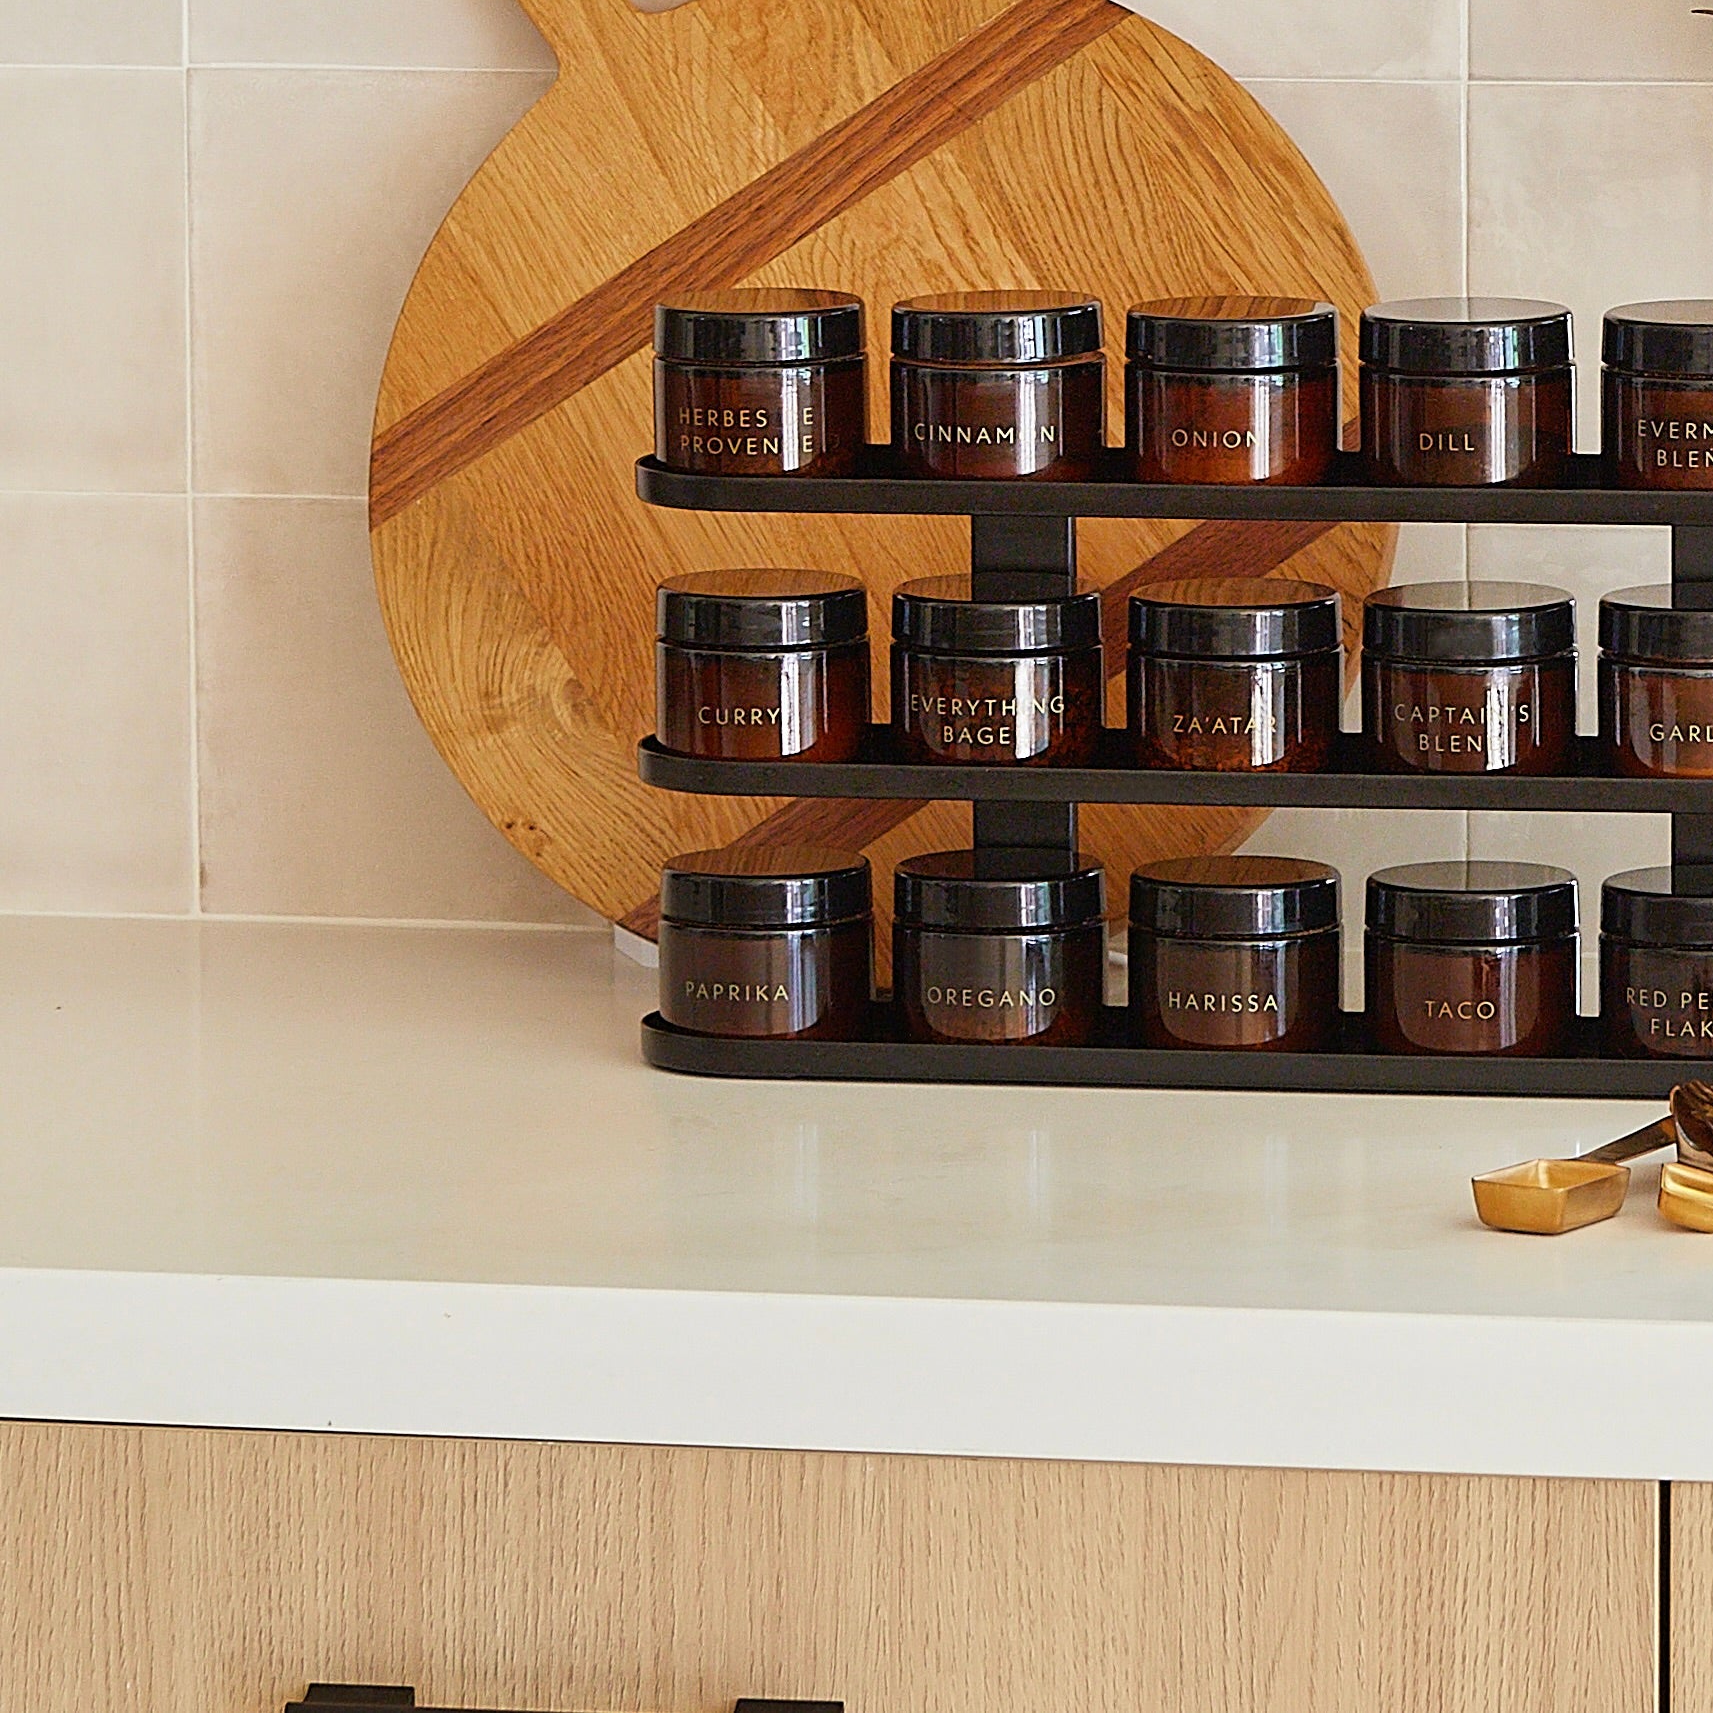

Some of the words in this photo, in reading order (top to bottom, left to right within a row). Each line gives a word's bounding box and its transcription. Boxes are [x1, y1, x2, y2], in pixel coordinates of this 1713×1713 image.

[678, 406, 769, 429] HERBES
[680, 433, 815, 456] PROVENE
[1171, 428, 1261, 450] ONION
[1418, 431, 1476, 453] DILL
[697, 705, 781, 727] CURRY
[910, 693, 1066, 717] EVERYTHNG
[1393, 703, 1530, 725] CAPTAI'S
[943, 723, 1014, 746] BAGE
[1418, 733, 1485, 754] BLEN
[685, 979, 790, 1003] PAPRIKA
[926, 986, 1058, 1009] OREGANO
[1167, 989, 1280, 1013] HARISSA
[1626, 985, 1668, 1009] RED
[1424, 998, 1497, 1021] TACO
